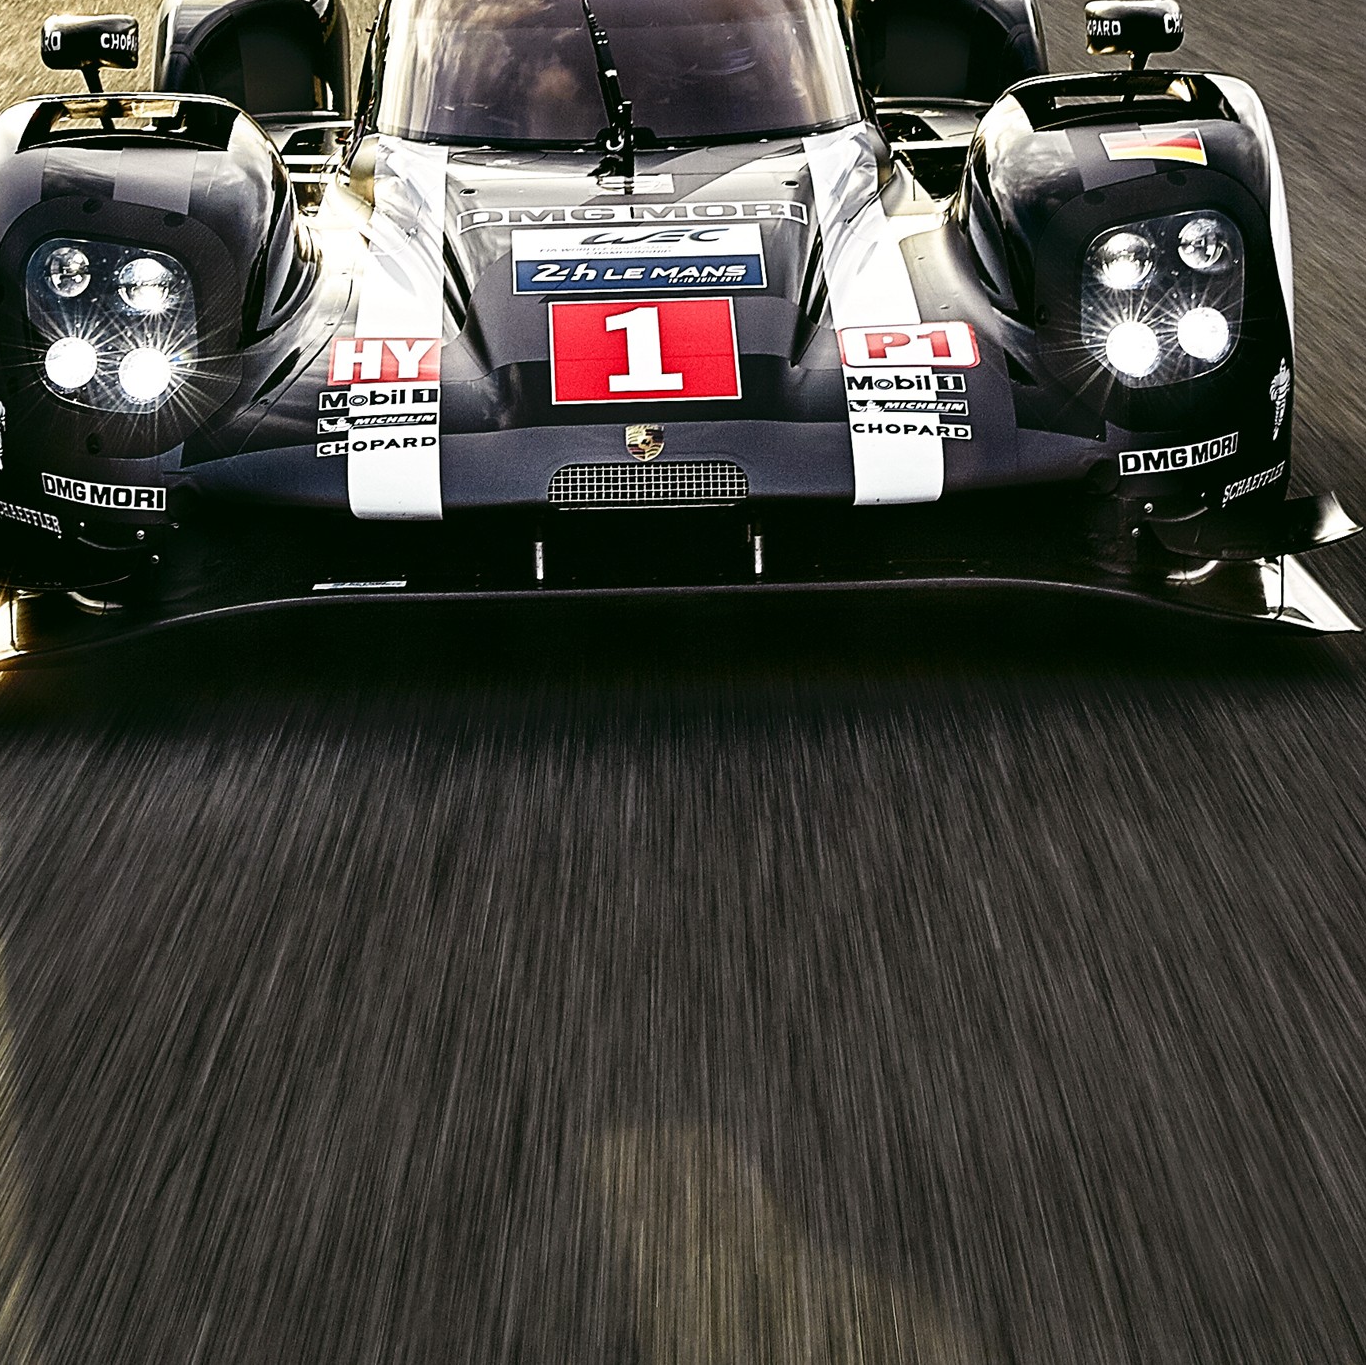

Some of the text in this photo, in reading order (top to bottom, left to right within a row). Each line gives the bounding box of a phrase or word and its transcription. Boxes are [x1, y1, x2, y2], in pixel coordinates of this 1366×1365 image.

[461, 202, 805, 232] DMG MORI
[580, 227, 730, 246] WEC
[603, 267, 645, 281] LE
[650, 264, 747, 279] MANS
[605, 306, 683, 392] 1
[864, 330, 951, 359] P1
[332, 339, 437, 382] HY
[846, 375, 931, 391] Mobil
[321, 388, 406, 406] Mobil
[884, 400, 965, 412] MICHELIN
[353, 413, 436, 426] MICHELIN
[852, 422, 969, 438] CHOPARD
[319, 436, 437, 453] CHOPARD
[1121, 432, 1238, 474] DMG MORI
[43, 474, 165, 510] DMG MORI
